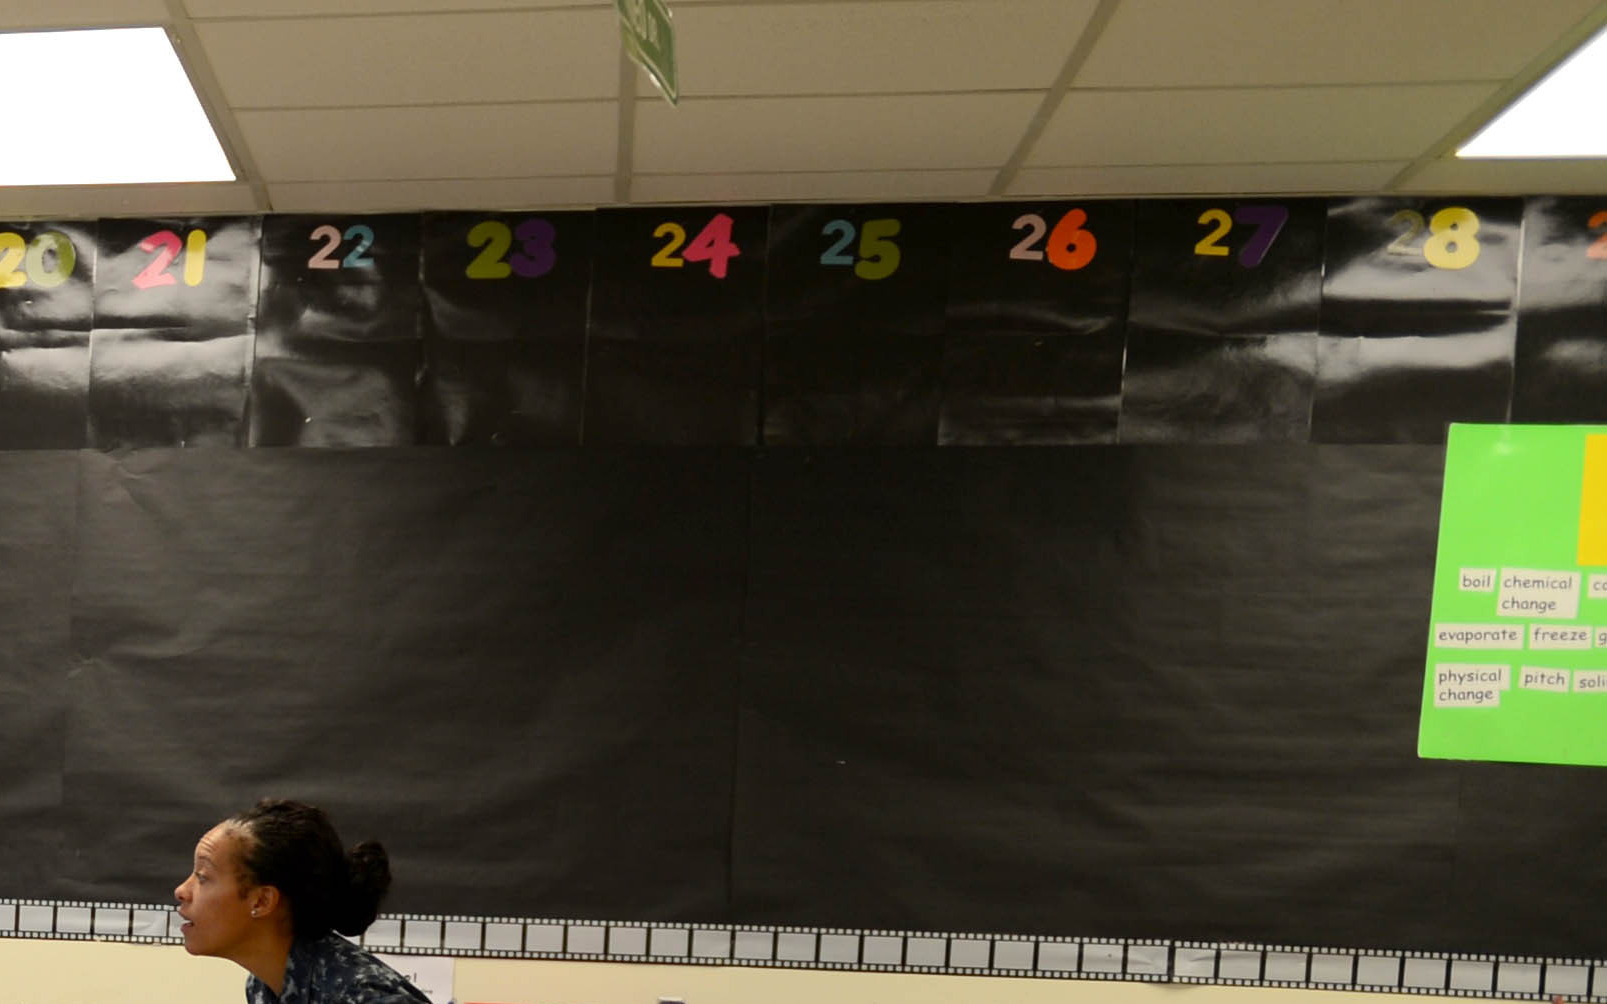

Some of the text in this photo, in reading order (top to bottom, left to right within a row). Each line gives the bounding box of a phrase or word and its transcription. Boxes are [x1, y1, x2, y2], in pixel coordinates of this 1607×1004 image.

[308, 225, 374, 269] 22
[466, 219, 557, 280] 23
[651, 214, 740, 279] 24
[820, 219, 900, 280] 25
[1009, 208, 1097, 270] 26
[1194, 206, 1289, 268] 27
[1387, 207, 1480, 270] 28
[132, 229, 206, 290] 21
[1462, 575, 1491, 588] boil
[1503, 576, 1572, 590] chemical
[1501, 597, 1557, 614] change
[1438, 628, 1518, 645] evaporate
[1533, 627, 1588, 643] freeze
[1438, 668, 1502, 687] physical
[1524, 672, 1565, 687] pitch
[1438, 687, 1494, 704] change
